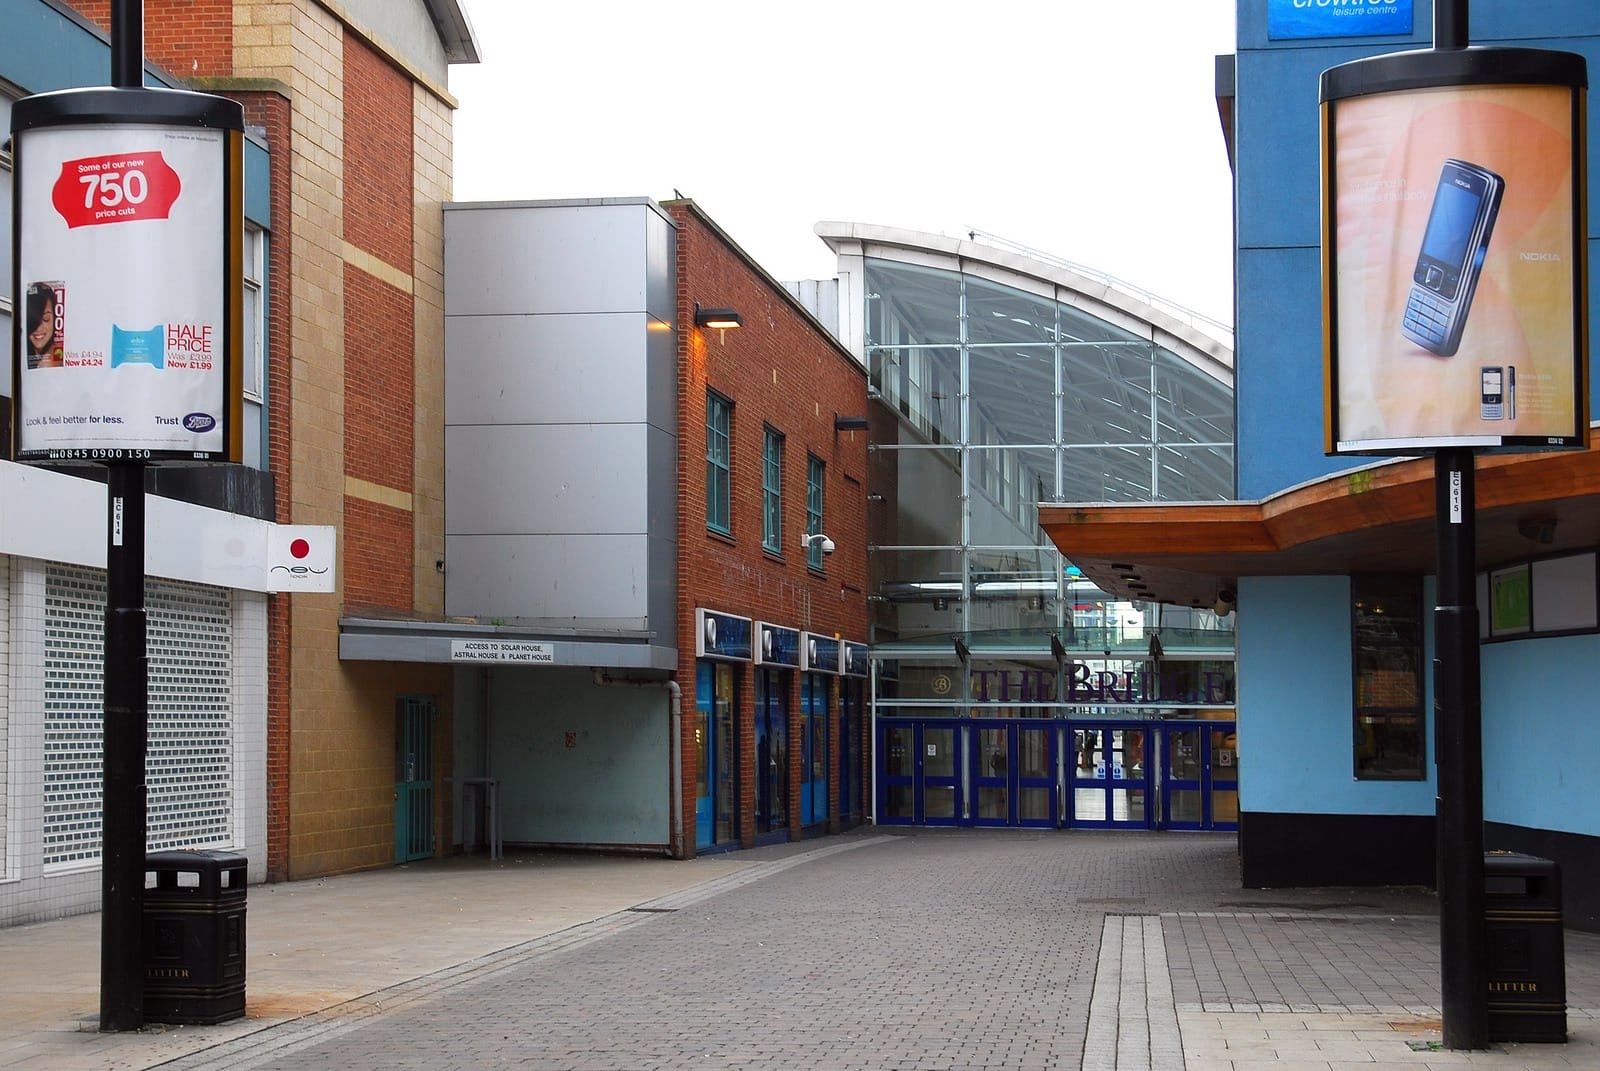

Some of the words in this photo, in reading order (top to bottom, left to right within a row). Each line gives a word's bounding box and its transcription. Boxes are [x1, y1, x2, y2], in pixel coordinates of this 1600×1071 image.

[1333, 8, 1364, 16] leisure
[1366, 6, 1398, 14] centre
[78, 162, 100, 173] Some
[102, 162, 110, 170] of
[112, 160, 126, 168] our
[128, 159, 144, 168] new
[79, 169, 148, 208] 750
[95, 209, 116, 219] price
[118, 206, 136, 216] cuts
[1520, 252, 1560, 261] NOKIA
[168, 323, 212, 340] HALF
[168, 338, 212, 352] PRICE
[190, 362, 212, 370] £1.99
[26, 417, 41, 426] Look
[42, 416, 48, 425] &
[48, 416, 62, 424] feel
[62, 415, 88, 424] better
[89, 415, 101, 424] for
[102, 415, 124, 424] less.
[154, 416, 179, 425] Trust
[60, 449, 88, 458] 0845
[92, 449, 122, 458] 0900
[128, 449, 150, 458] 150
[970, 669, 1057, 704] THE
[1488, 982, 1537, 992] LITTER
